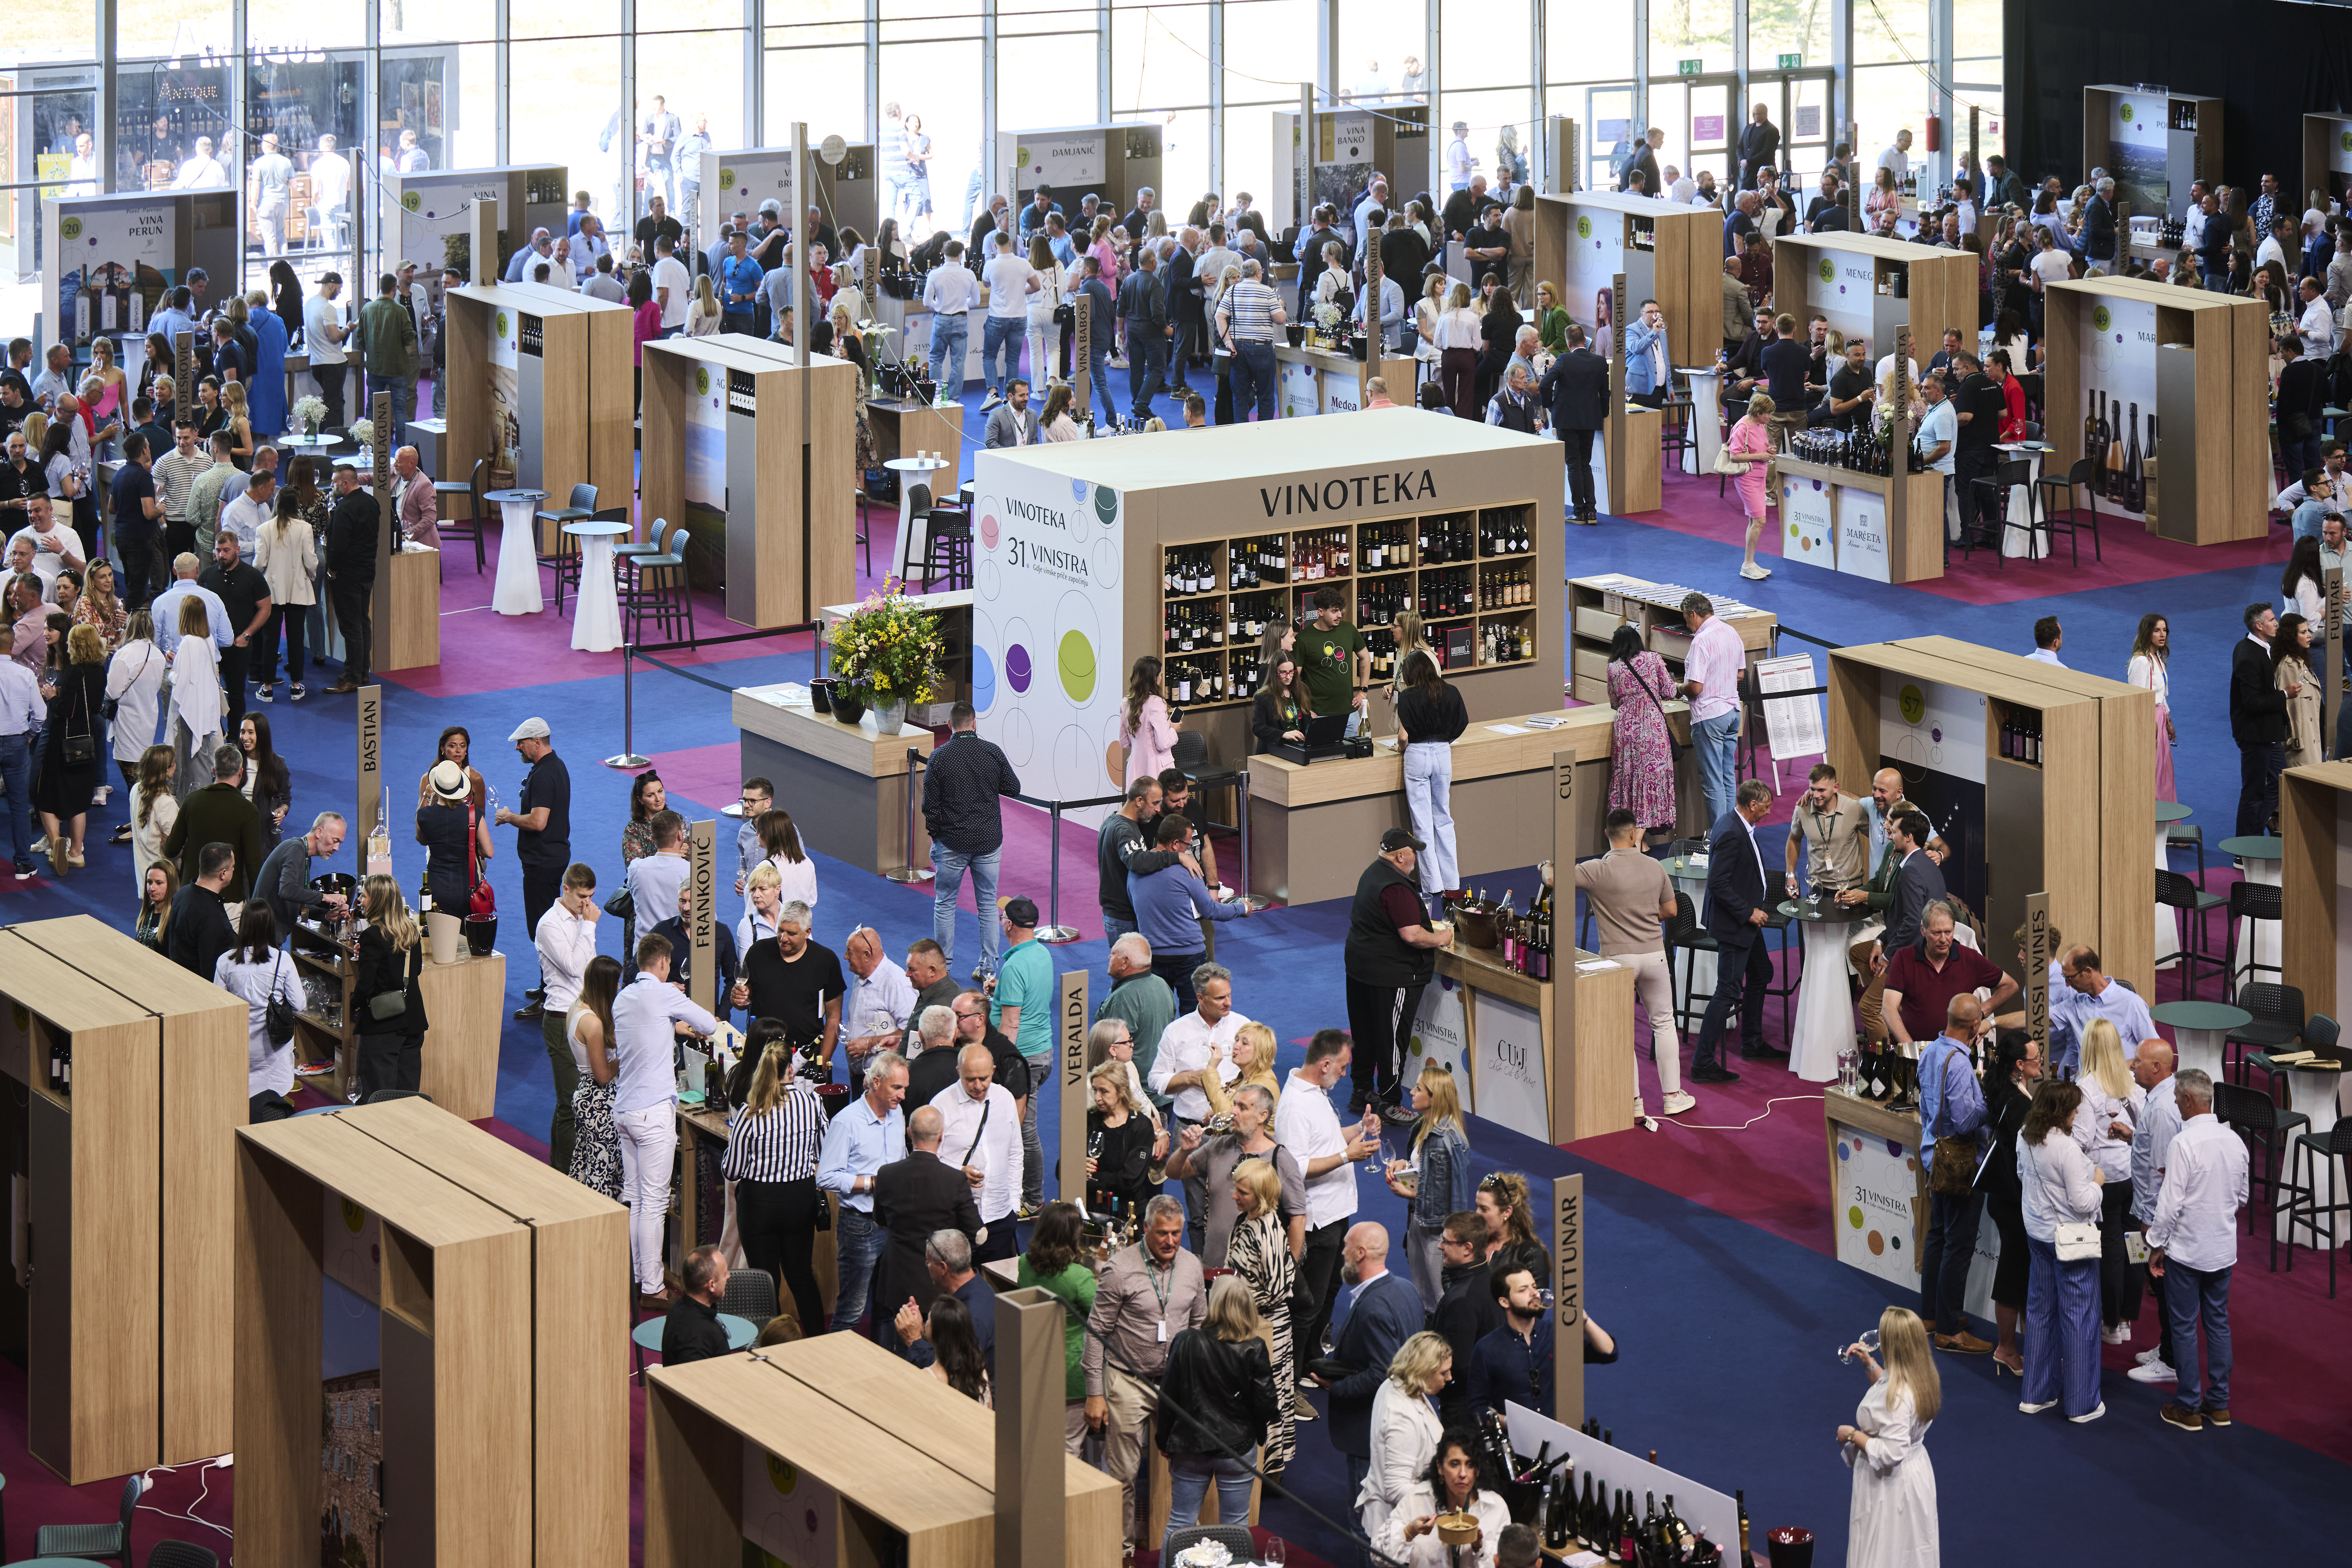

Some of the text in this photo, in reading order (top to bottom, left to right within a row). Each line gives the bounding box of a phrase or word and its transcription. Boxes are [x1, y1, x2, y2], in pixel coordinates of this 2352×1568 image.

[2123, 110, 2131, 118] 15
[1347, 126, 1365, 135] VINA
[1337, 136, 1364, 145] BANKO
[1052, 144, 1095, 157] DAMJANIĆ
[720, 175, 732, 185] 18
[406, 198, 418, 209] 19
[139, 215, 163, 225] VINA
[65, 223, 79, 234] 20
[129, 226, 162, 237] PERUN
[1580, 224, 1588, 233] 51
[1822, 266, 1832, 277] 50
[1846, 268, 1873, 281] MENEG
[2097, 314, 2108, 325] 49
[498, 321, 506, 332] 61
[2137, 332, 2156, 343] MAR
[1897, 333, 1906, 391] MARČETA
[176, 342, 189, 403] DEŠKOVIĆ
[699, 376, 708, 389] 60
[716, 378, 725, 390] AG
[1289, 394, 1295, 404] 31
[1331, 396, 1357, 411] Medea
[378, 401, 387, 491] AGROLAGUNA
[1261, 469, 1436, 517] VINOTEKA
[1006, 497, 1066, 530] VINOTEKA
[1793, 511, 1825, 524] 31 VINISTRA
[1031, 543, 1088, 576] VINISTRA
[1033, 564, 1088, 588] Gdje vinske priče započinju
[2330, 579, 2340, 640] FUHTAR
[1451, 645, 1465, 655] RIEDEL
[1905, 697, 1919, 714] 57
[364, 701, 376, 772] BASTIAN
[1560, 764, 1572, 800] CUJ
[693, 836, 710, 948] FRANKOVIĆ
[2032, 909, 2044, 1084] DGRASSI WINES
[1068, 986, 1082, 1086] VERALDA
[1415, 1018, 1457, 1042] 31 VINISTRA
[1869, 1190, 1907, 1213] VINISTRA
[1562, 1195, 1577, 1326] CATTUNAR
